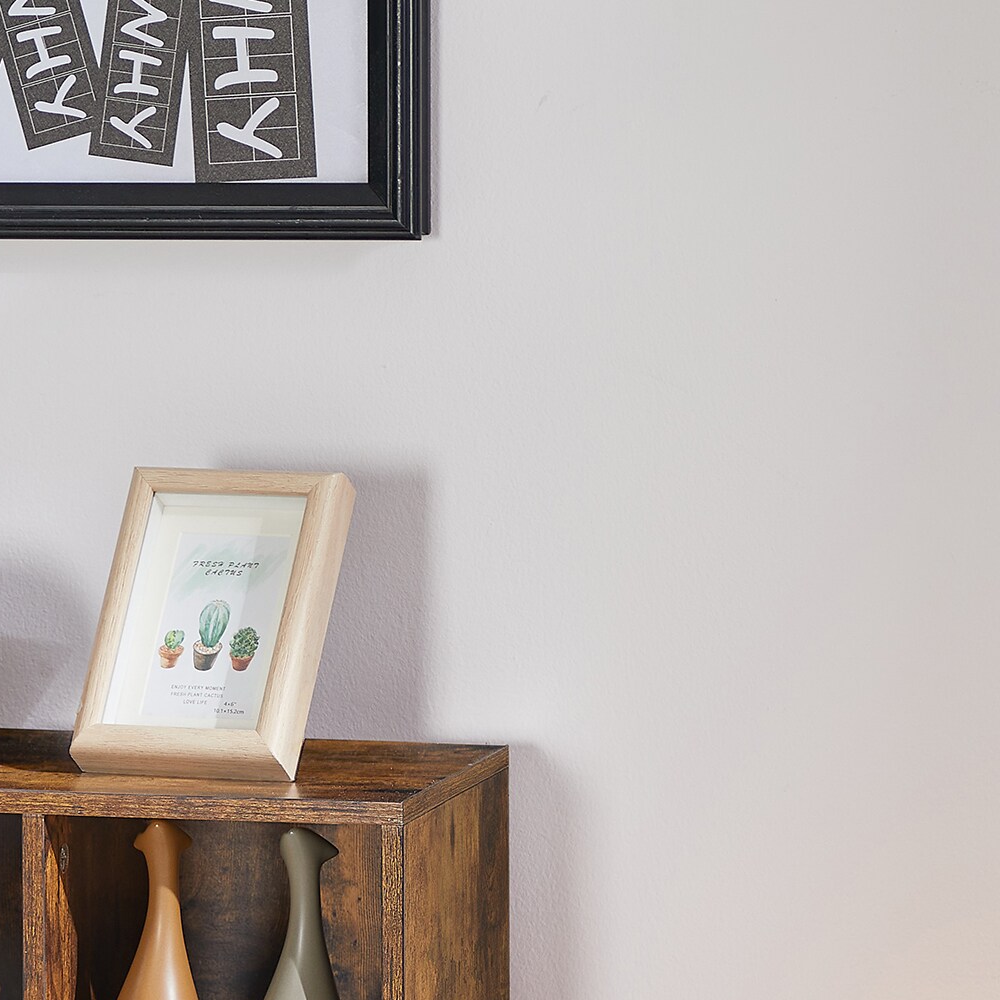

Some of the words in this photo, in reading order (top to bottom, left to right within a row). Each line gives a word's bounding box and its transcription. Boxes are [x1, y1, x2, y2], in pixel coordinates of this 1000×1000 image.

[211, 0, 283, 159] HY
[228, 561, 260, 569] PLANT
[204, 569, 243, 577] CACTUS
